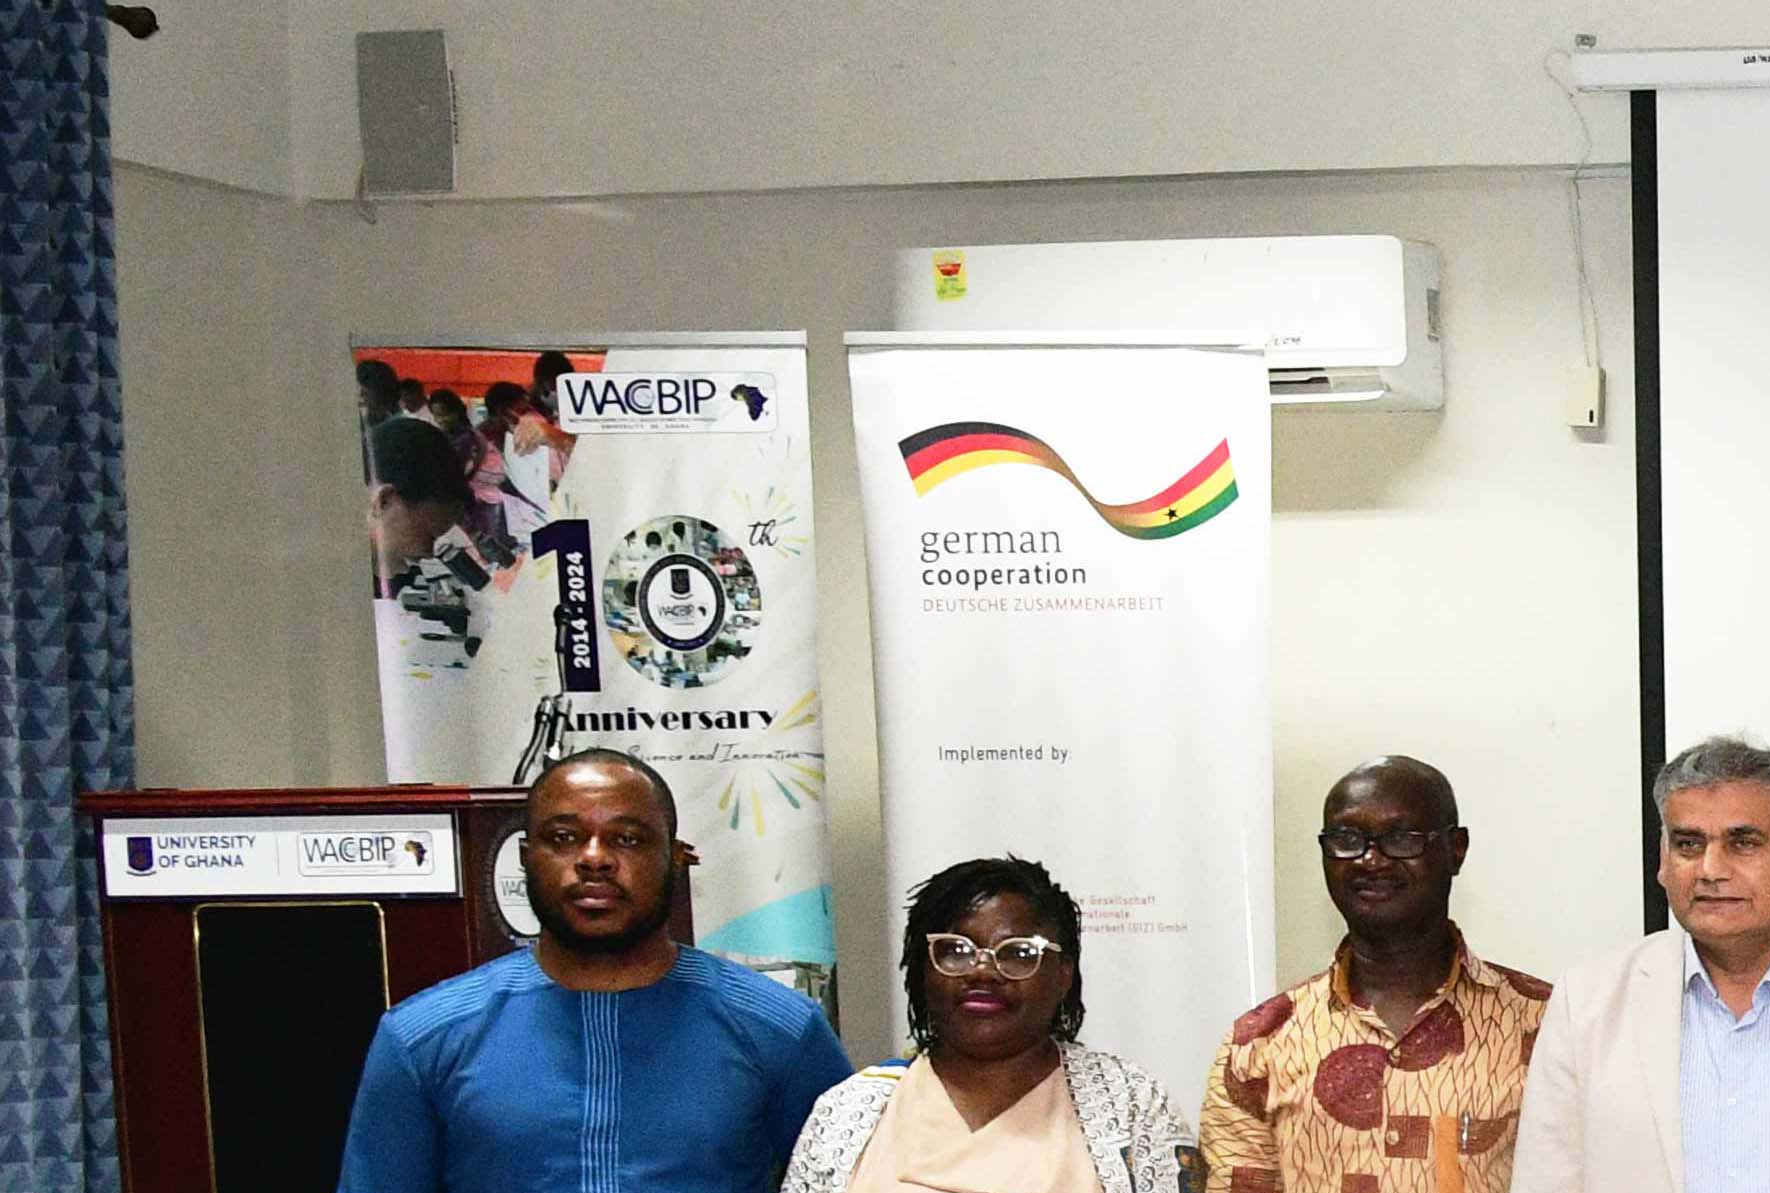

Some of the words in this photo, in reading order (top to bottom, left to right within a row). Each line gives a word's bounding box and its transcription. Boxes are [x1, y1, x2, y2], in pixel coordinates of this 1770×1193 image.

[920, 530, 1062, 563] german
[566, 551, 590, 602] 2024
[922, 562, 1086, 591] cooperation
[923, 598, 1008, 612] DEUTSCHE
[1014, 597, 1163, 611] ZUSAMMENARBEIT
[568, 619, 591, 668] 2014
[938, 745, 1043, 764] Implemented
[157, 836, 255, 849] UNIVERSITY
[159, 855, 179, 868] OF
[184, 854, 244, 868] GHANA
